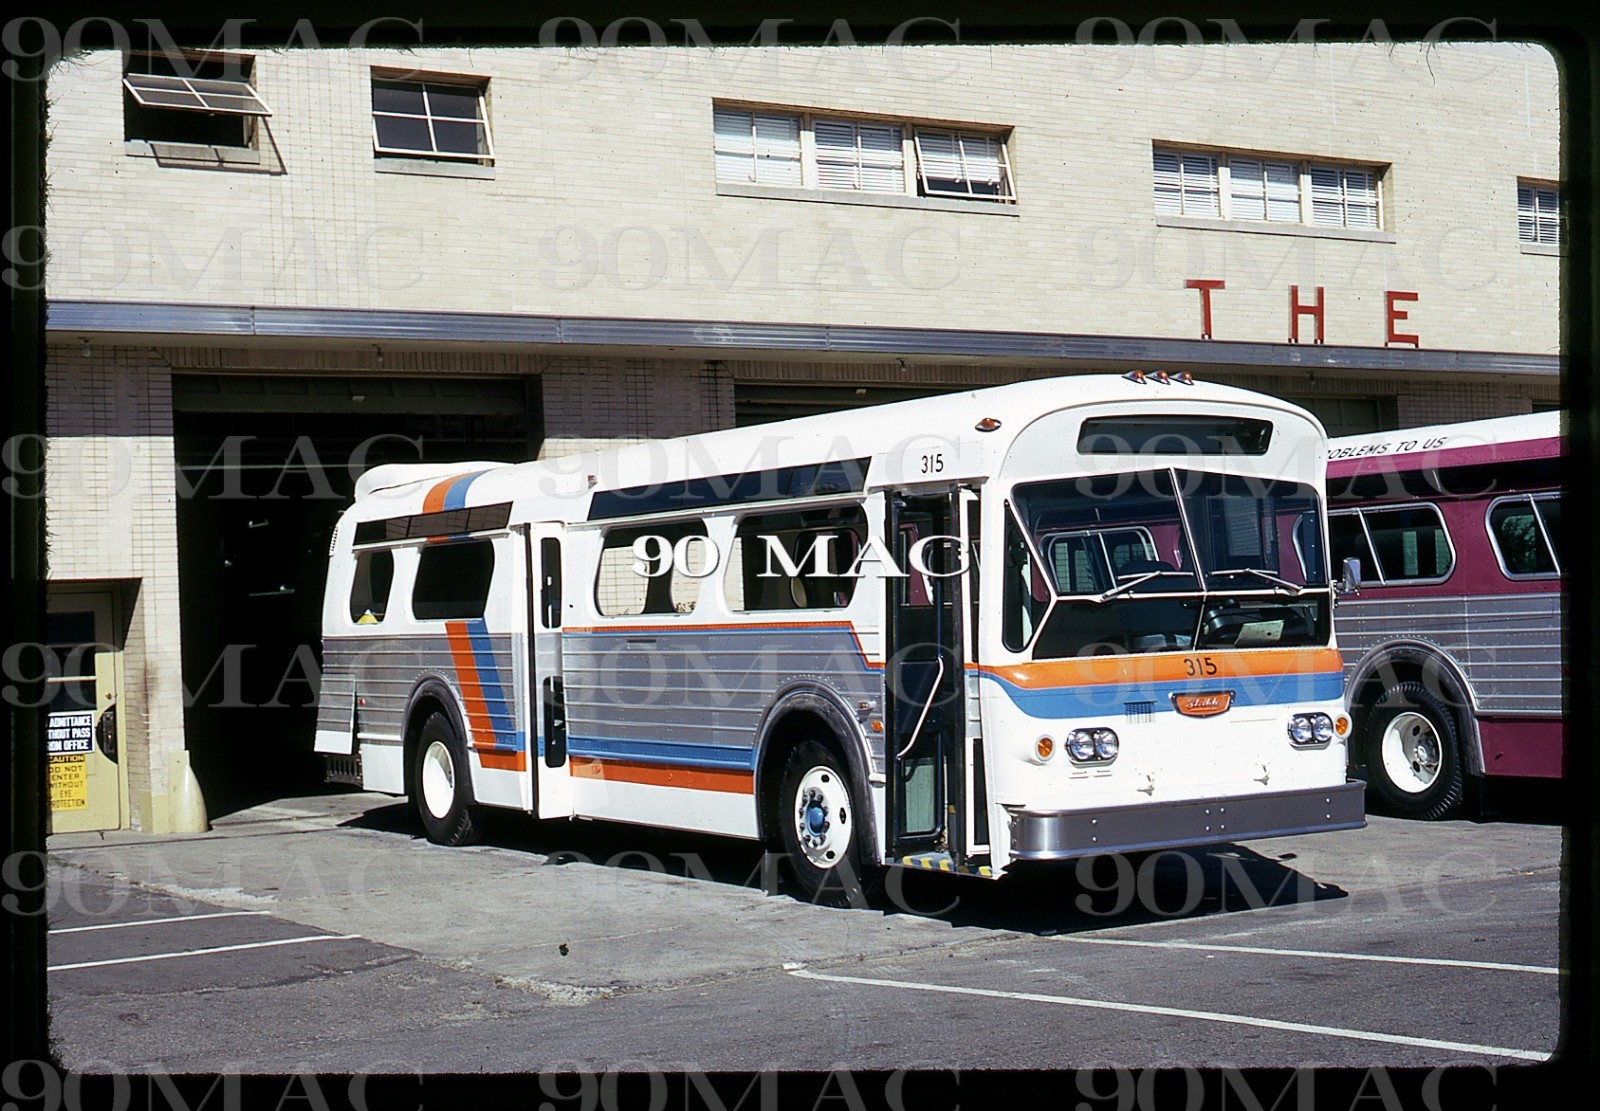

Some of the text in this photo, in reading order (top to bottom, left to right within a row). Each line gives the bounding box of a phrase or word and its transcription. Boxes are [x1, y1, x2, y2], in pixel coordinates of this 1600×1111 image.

[1185, 279, 1419, 348] THE
[1327, 436, 1448, 459] OBLEMS TO US
[921, 453, 944, 474] 315
[1183, 657, 1217, 676] 315
[49, 716, 92, 728] ADMITTANCE
[71, 727, 91, 739] PASS
[63, 739, 89, 751] OFFICE
[64, 765, 82, 773] NOT
[51, 773, 80, 781] ENTER
[60, 790, 72, 798] EYE
